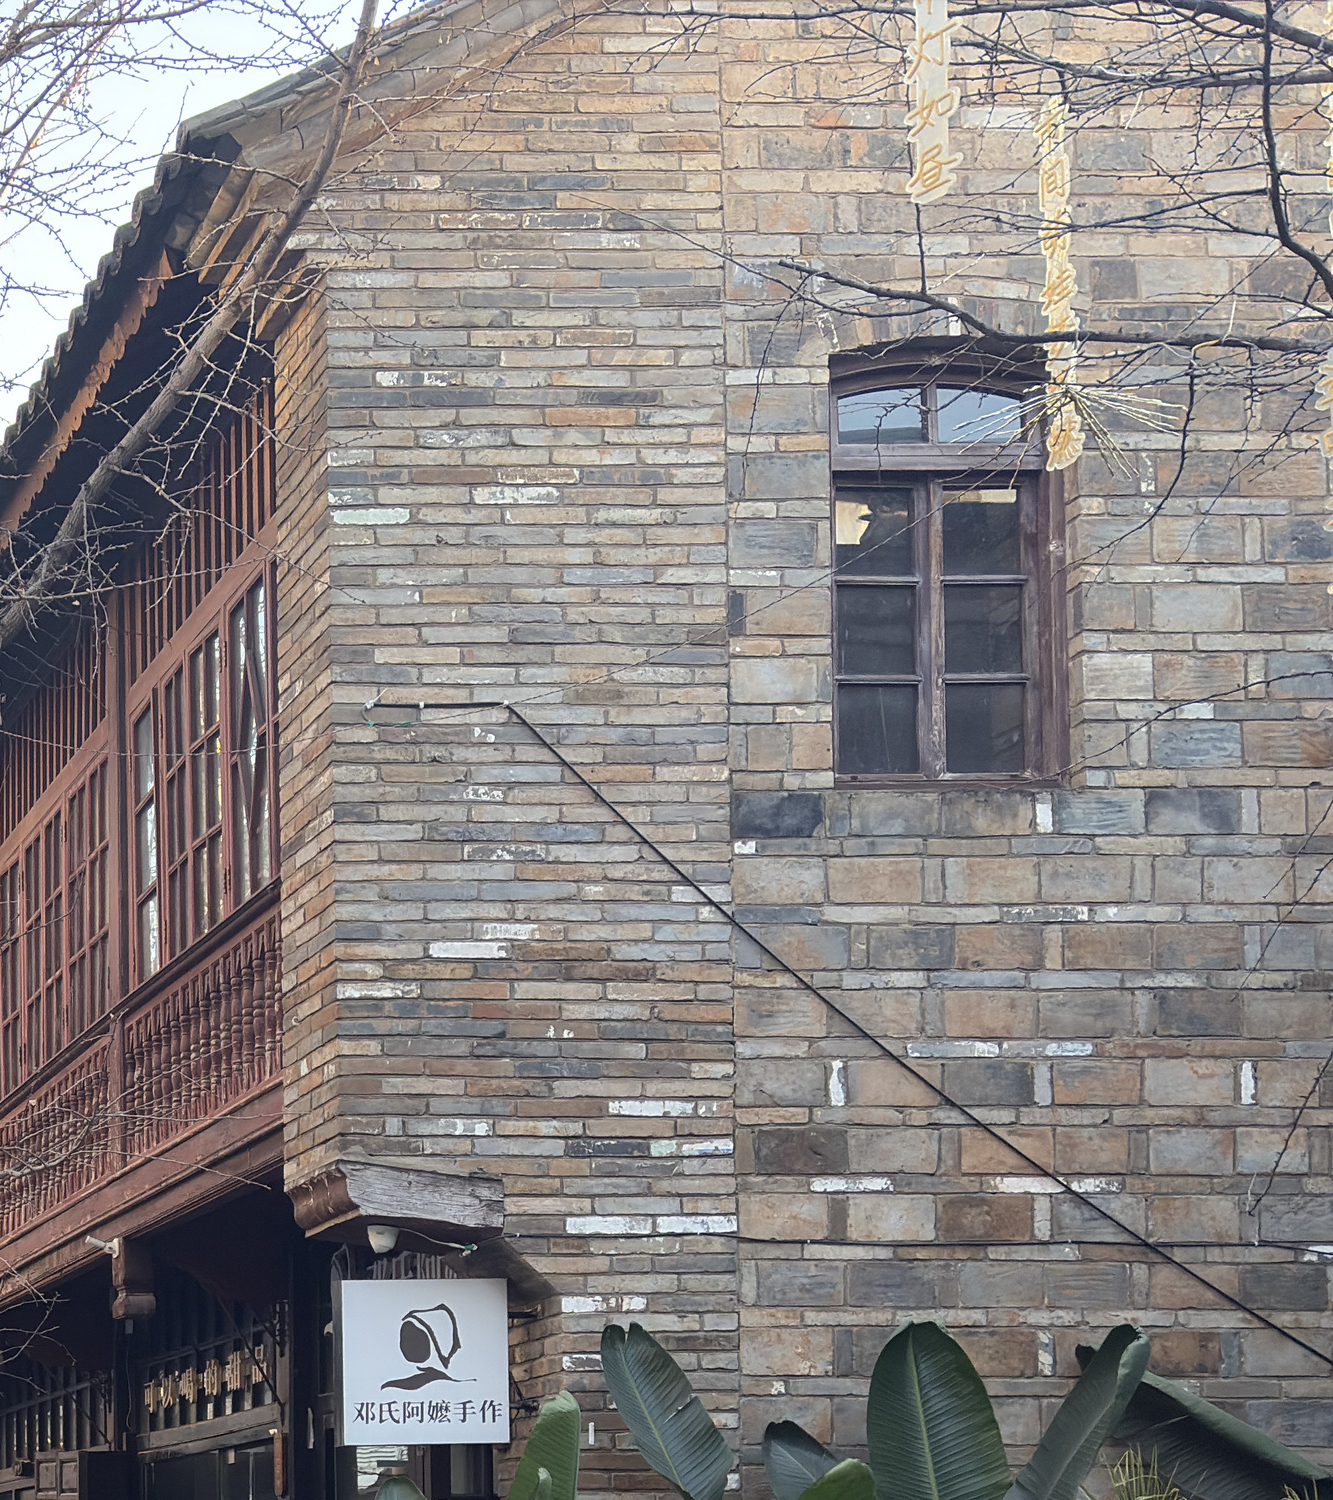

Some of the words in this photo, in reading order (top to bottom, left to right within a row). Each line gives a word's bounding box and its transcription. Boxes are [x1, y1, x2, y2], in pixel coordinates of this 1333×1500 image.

[351, 1399, 503, 1425] 邓氏阿嬷手作
